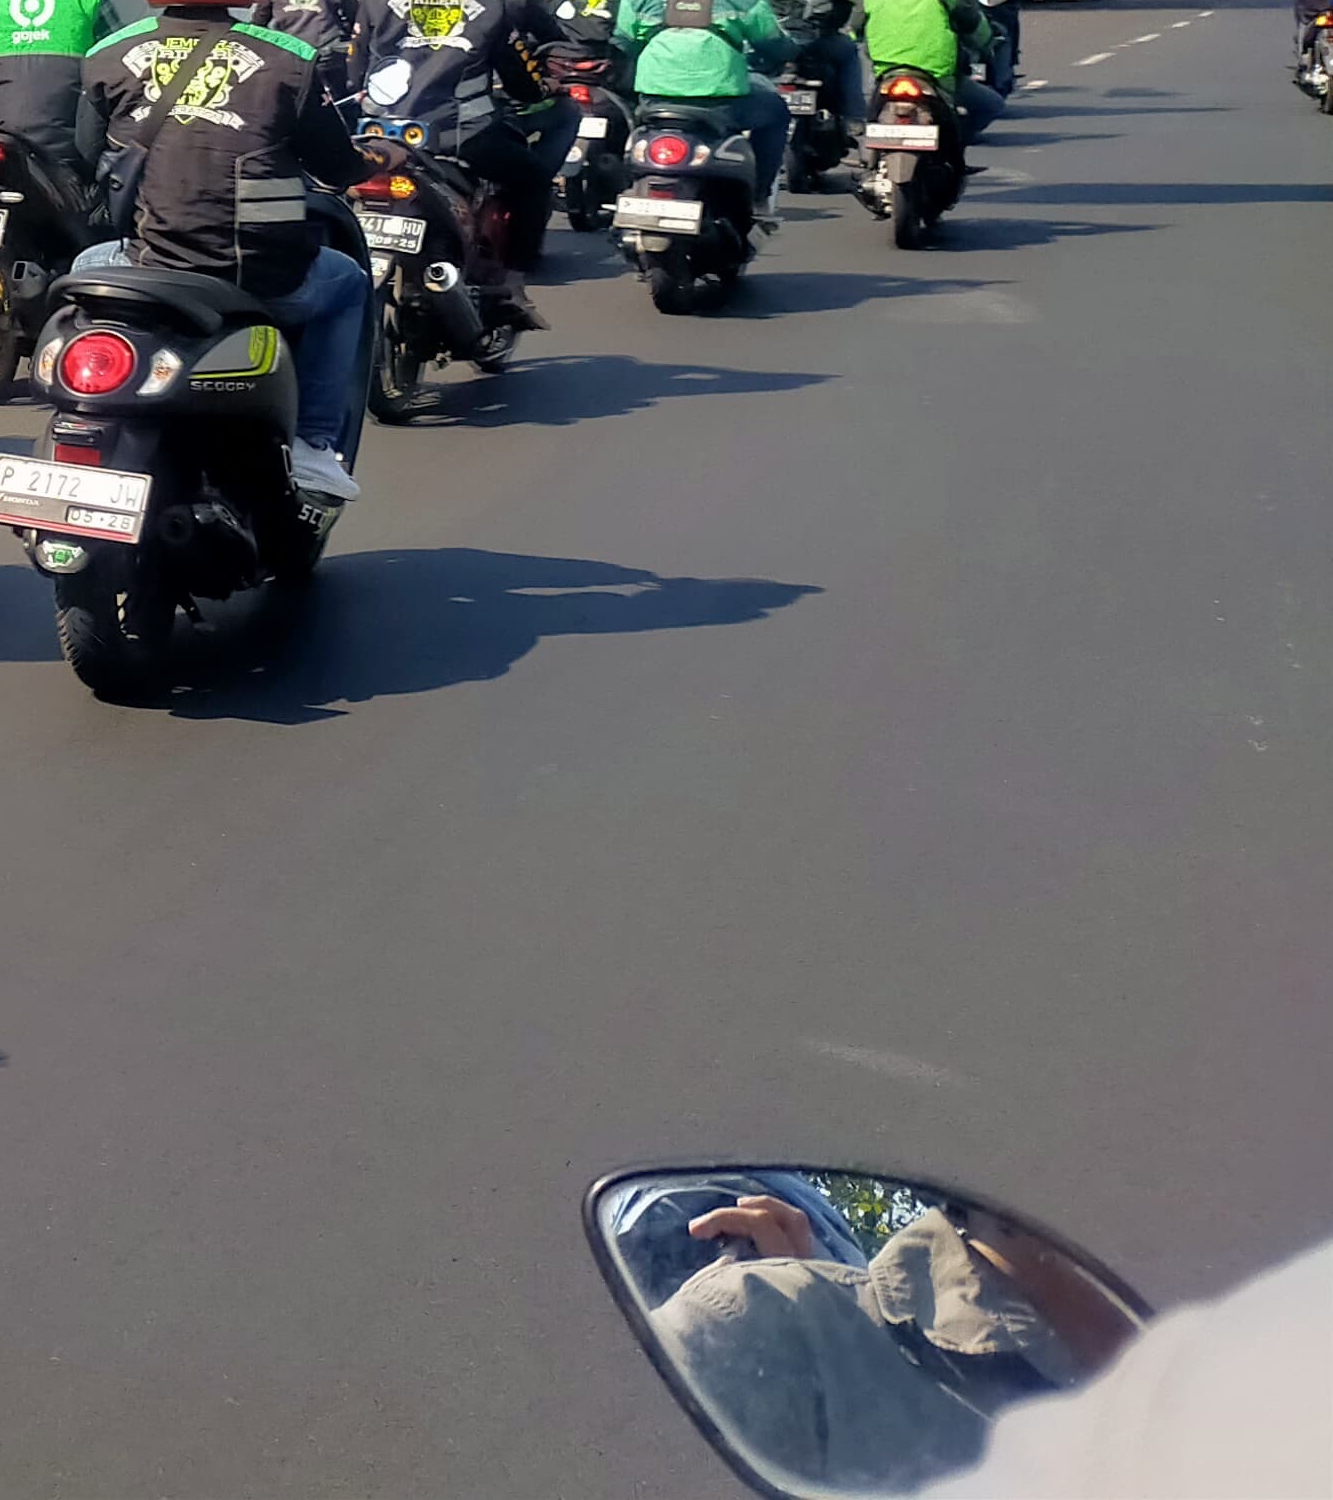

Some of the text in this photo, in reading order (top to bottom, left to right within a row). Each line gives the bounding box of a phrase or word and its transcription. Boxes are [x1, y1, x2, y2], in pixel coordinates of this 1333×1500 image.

[11, 28, 51, 45] gojek
[0, 465, 15, 487] P
[26, 470, 82, 498] 2172
